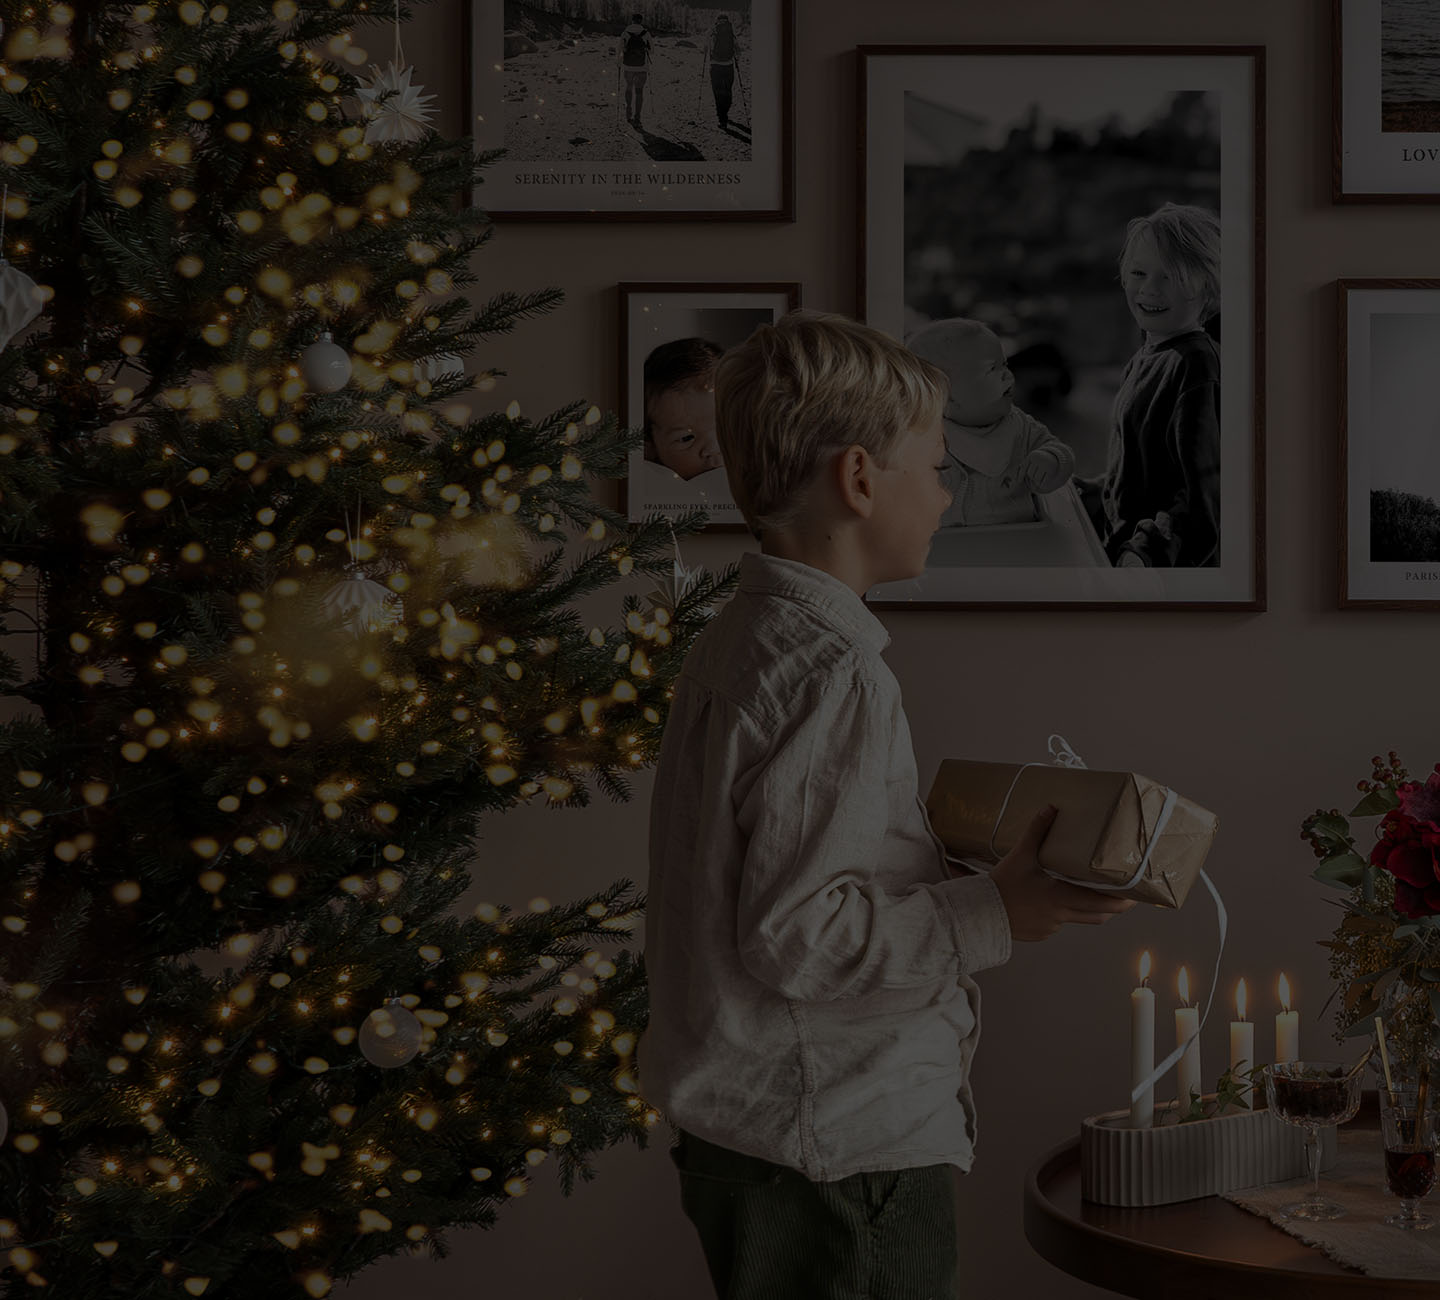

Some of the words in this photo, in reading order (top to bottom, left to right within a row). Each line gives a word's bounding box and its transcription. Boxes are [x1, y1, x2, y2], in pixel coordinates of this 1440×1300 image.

[514, 173, 587, 185] SERENITY
[591, 173, 608, 185] IN
[613, 173, 642, 185] THE
[647, 173, 742, 185] WILDERNESS
[643, 503, 688, 511] SPARKLING
[713, 503, 738, 511] PRECI
